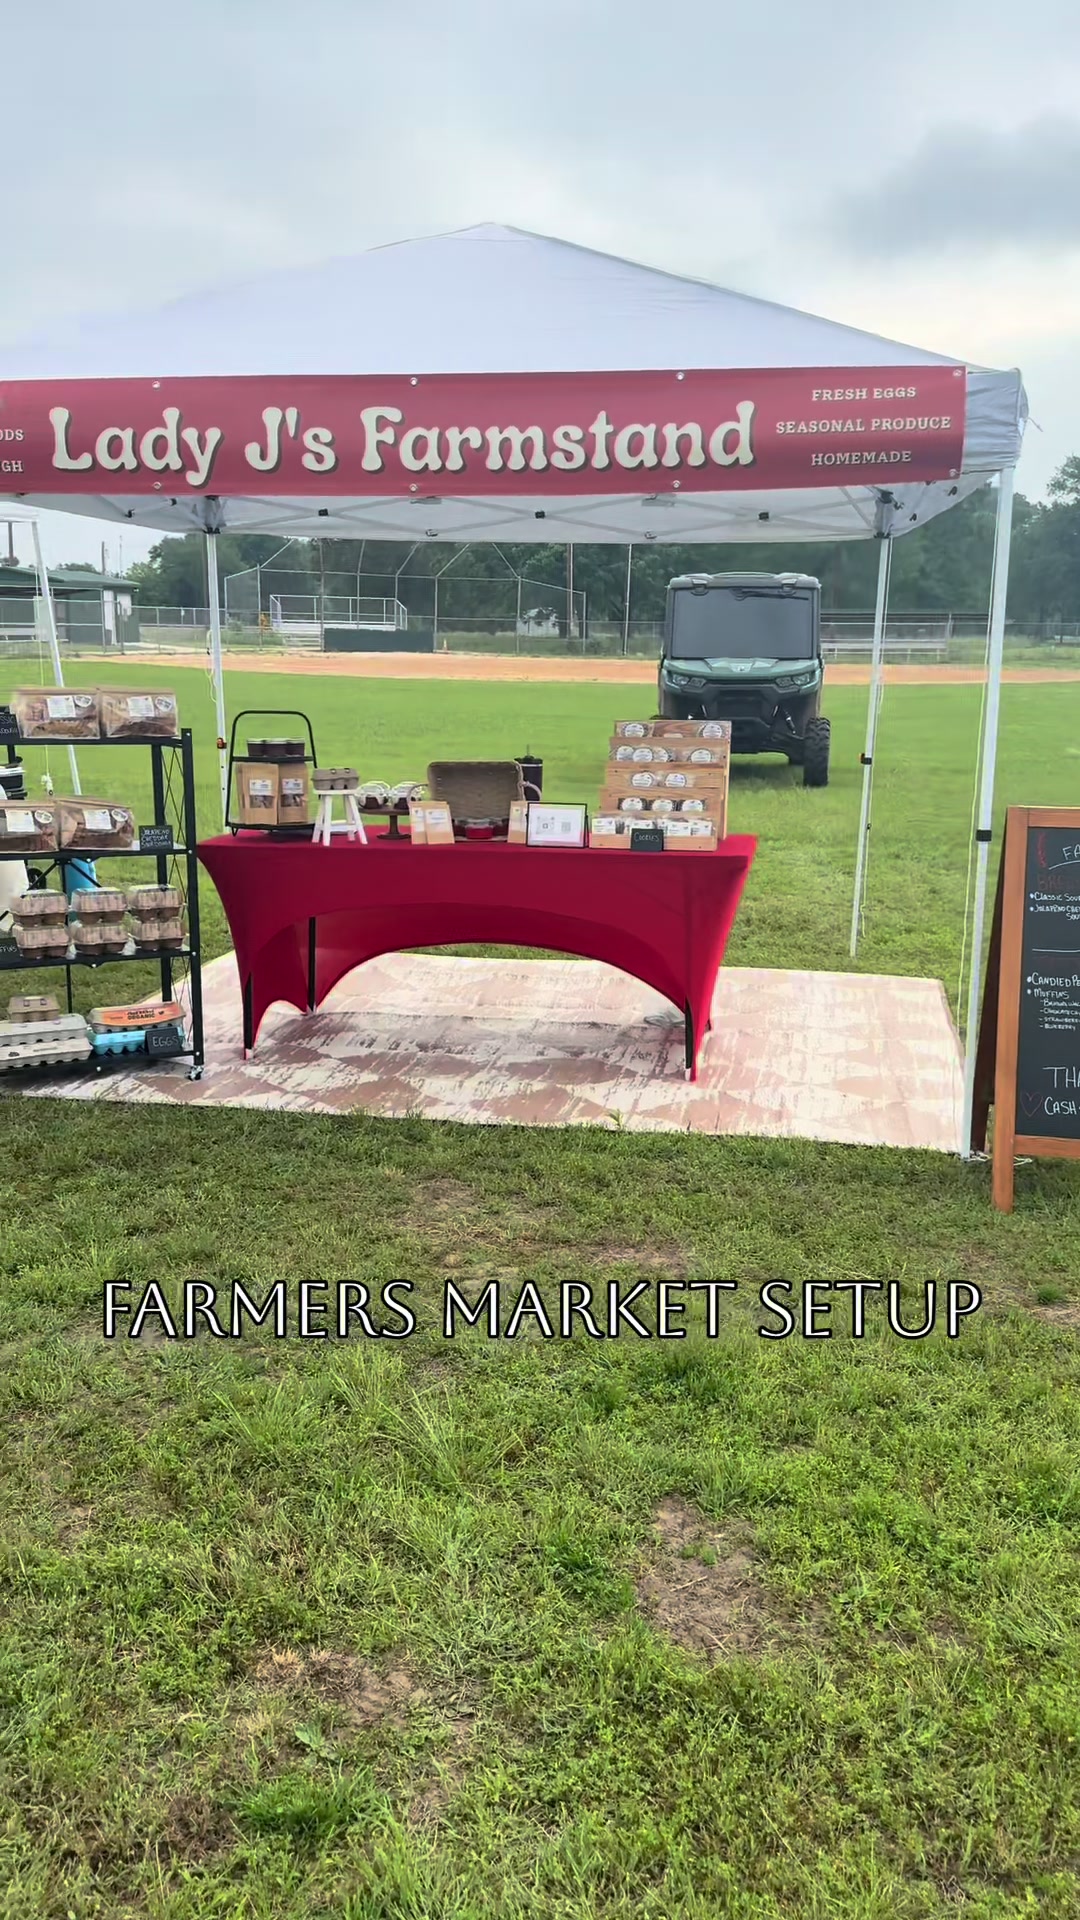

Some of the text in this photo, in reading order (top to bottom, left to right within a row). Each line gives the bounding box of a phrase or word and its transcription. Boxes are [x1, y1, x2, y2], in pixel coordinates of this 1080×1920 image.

[811, 386, 917, 402] FRESH EGGS
[775, 415, 952, 434] SEASONAL PRODUCE
[49, 400, 756, 487] Lady J's Farmstand
[810, 449, 913, 466] HOMEMADE
[1031, 971, 1072, 988] CANDIED
[152, 1035, 179, 1048] EGGS
